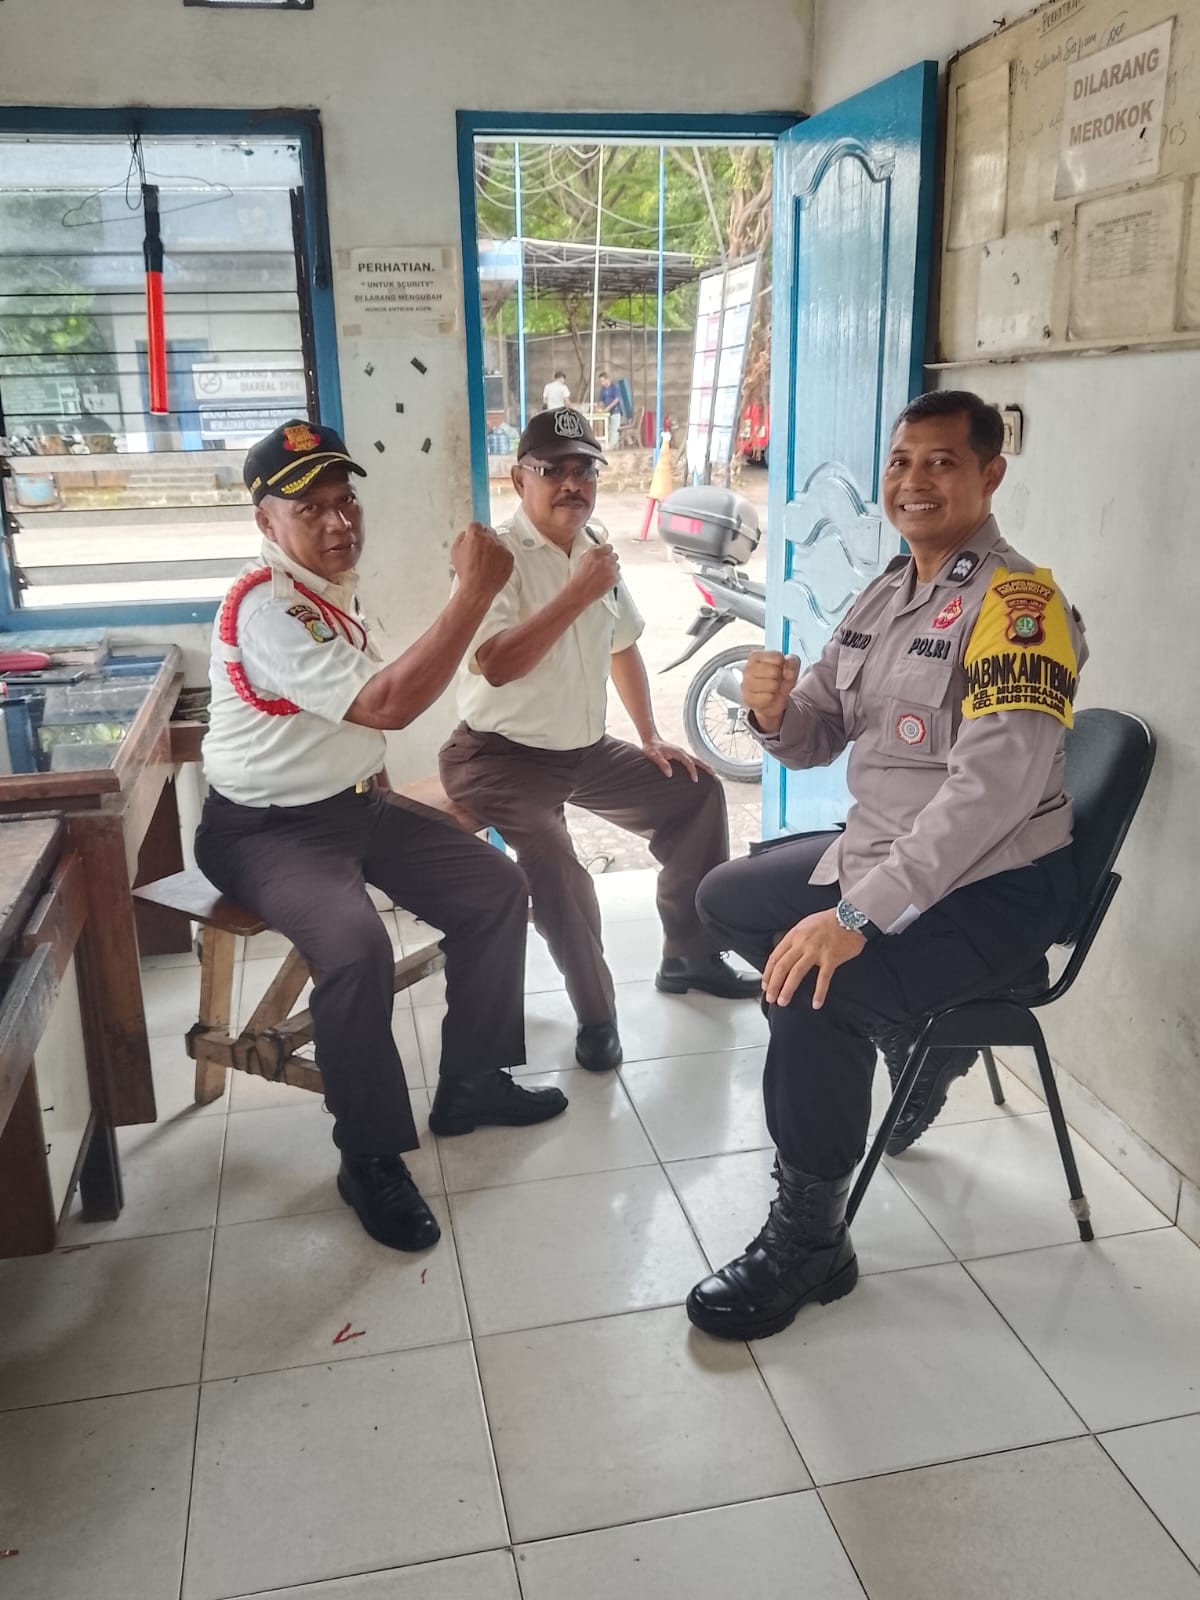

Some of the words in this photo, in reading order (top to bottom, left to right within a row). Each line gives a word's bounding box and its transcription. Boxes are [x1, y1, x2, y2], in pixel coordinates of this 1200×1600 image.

[1072, 48, 1160, 101] DILARANG
[1069, 98, 1154, 147] MEROKOK
[358, 262, 435, 272] PERHATIAN.
[364, 294, 396, 302] LARANG
[398, 293, 442, 302] MENGUBAH
[908, 637, 951, 660] POLRI
